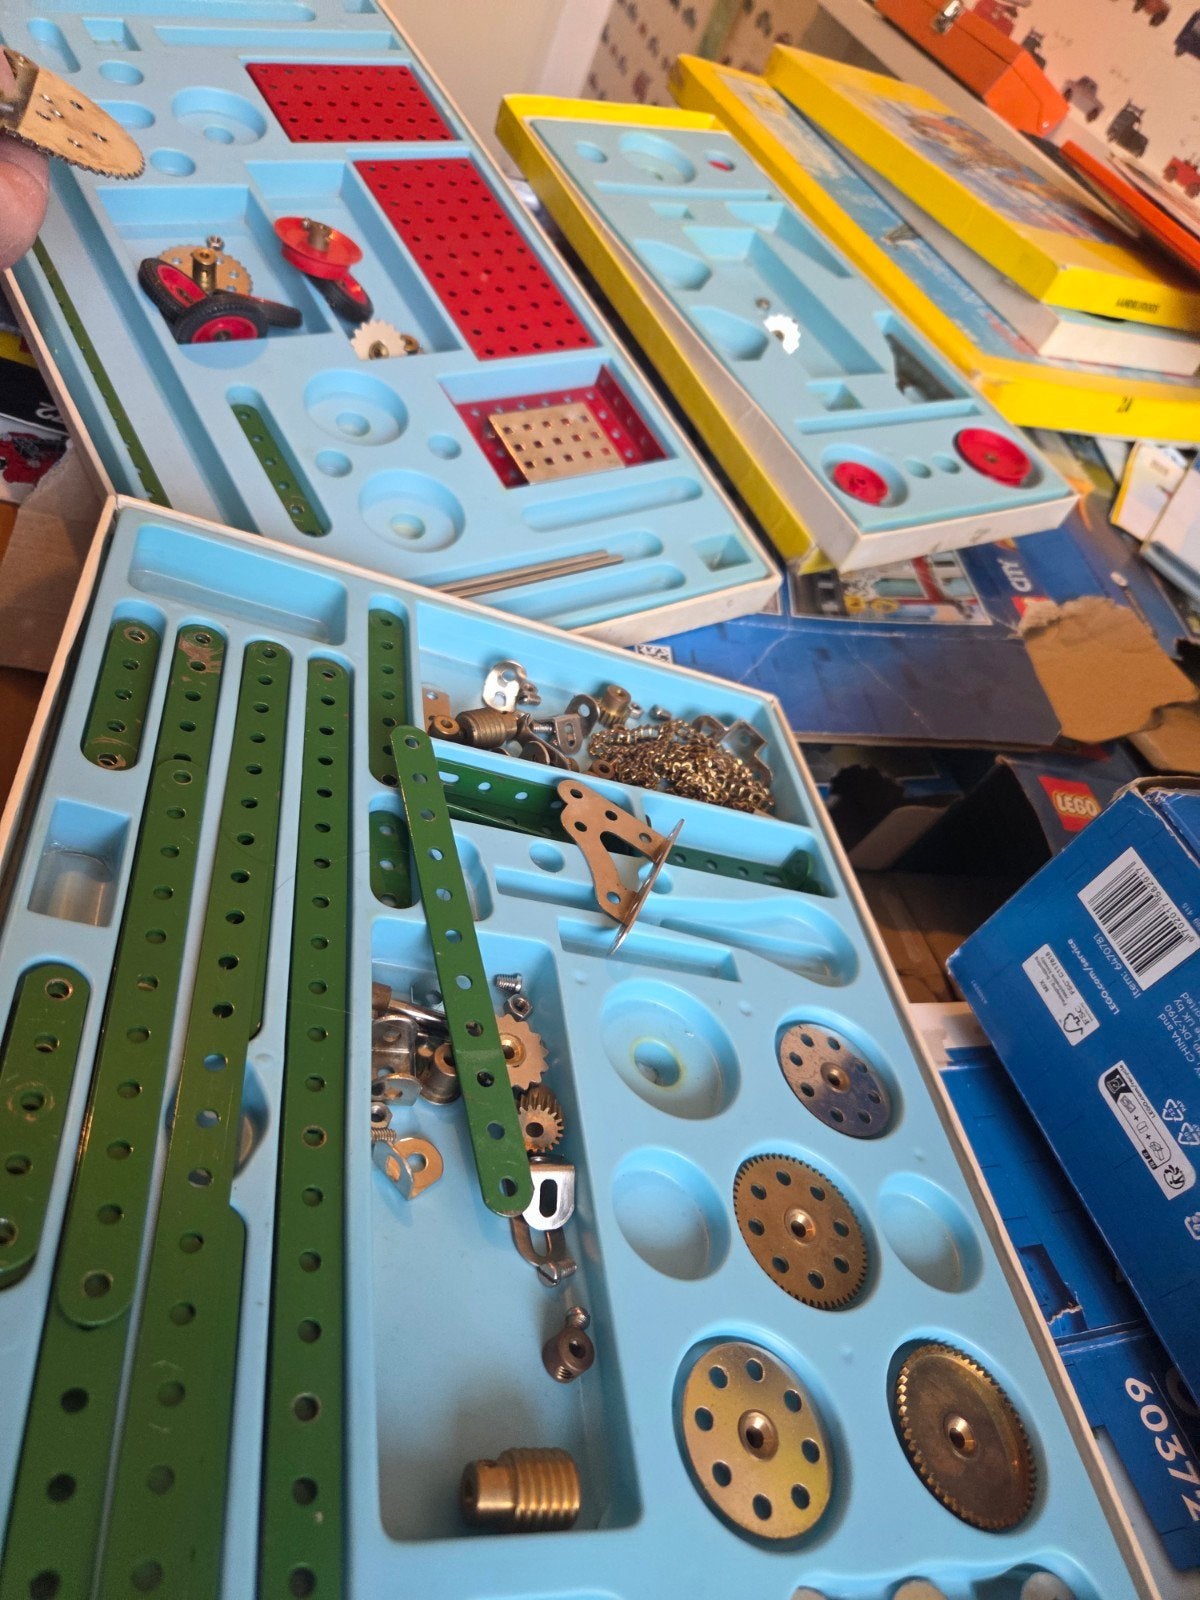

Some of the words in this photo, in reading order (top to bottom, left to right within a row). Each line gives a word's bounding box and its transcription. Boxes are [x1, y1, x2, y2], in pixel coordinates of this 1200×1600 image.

[997, 559, 1033, 592] CITY
[1053, 792, 1100, 818] LEGO
[1092, 933, 1123, 971] 6470781
[1067, 938, 1121, 1016] LEGO.com/service
[1120, 971, 1142, 999] Item:
[1074, 1005, 1091, 1026] FSC
[1174, 999, 1186, 1012] by
[1182, 1011, 1196, 1028] UK
[1157, 1013, 1175, 1031] and
[1164, 1004, 1193, 1041] DK-7190
[1172, 1031, 1196, 1062] CHINA
[1119, 1064, 1157, 1120] LEGO.com/recycle
